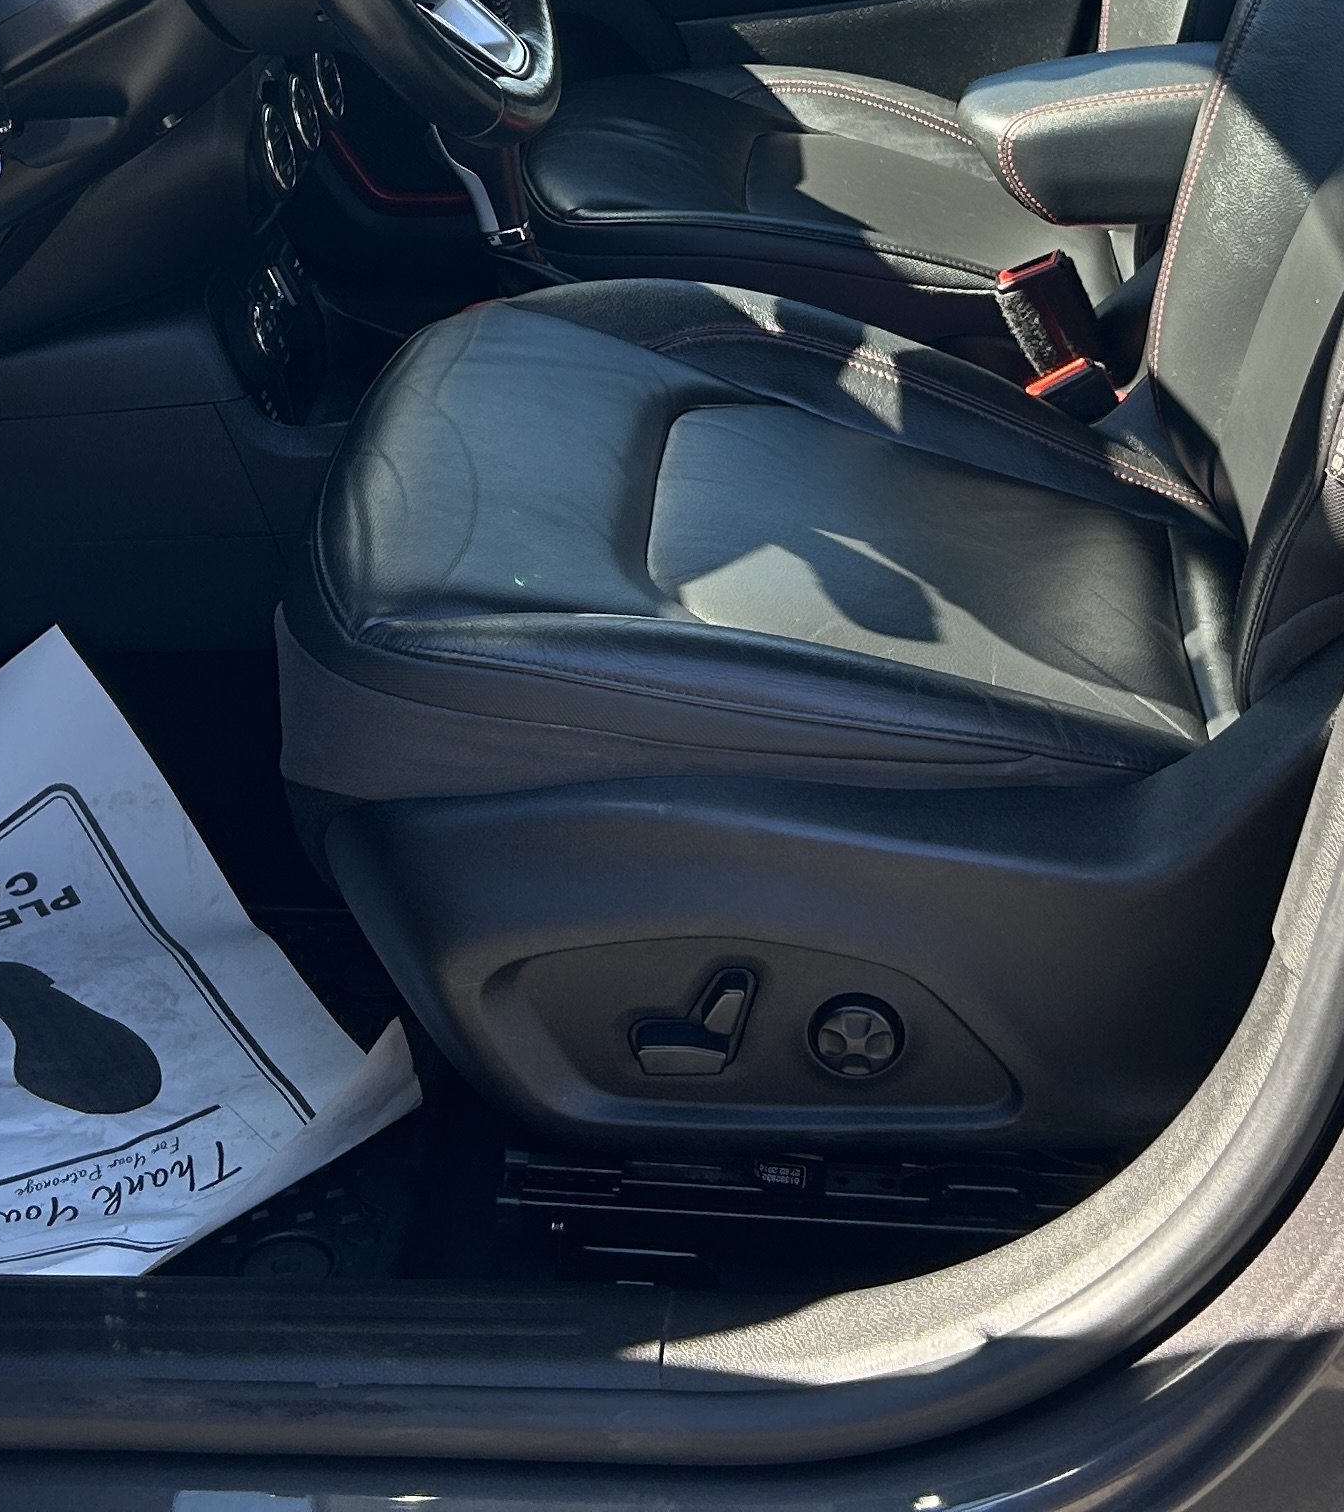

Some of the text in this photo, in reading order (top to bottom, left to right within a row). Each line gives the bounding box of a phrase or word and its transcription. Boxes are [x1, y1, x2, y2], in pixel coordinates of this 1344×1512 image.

[14, 1136, 180, 1197] For Your Patronage
[91, 1140, 243, 1216] Thank
